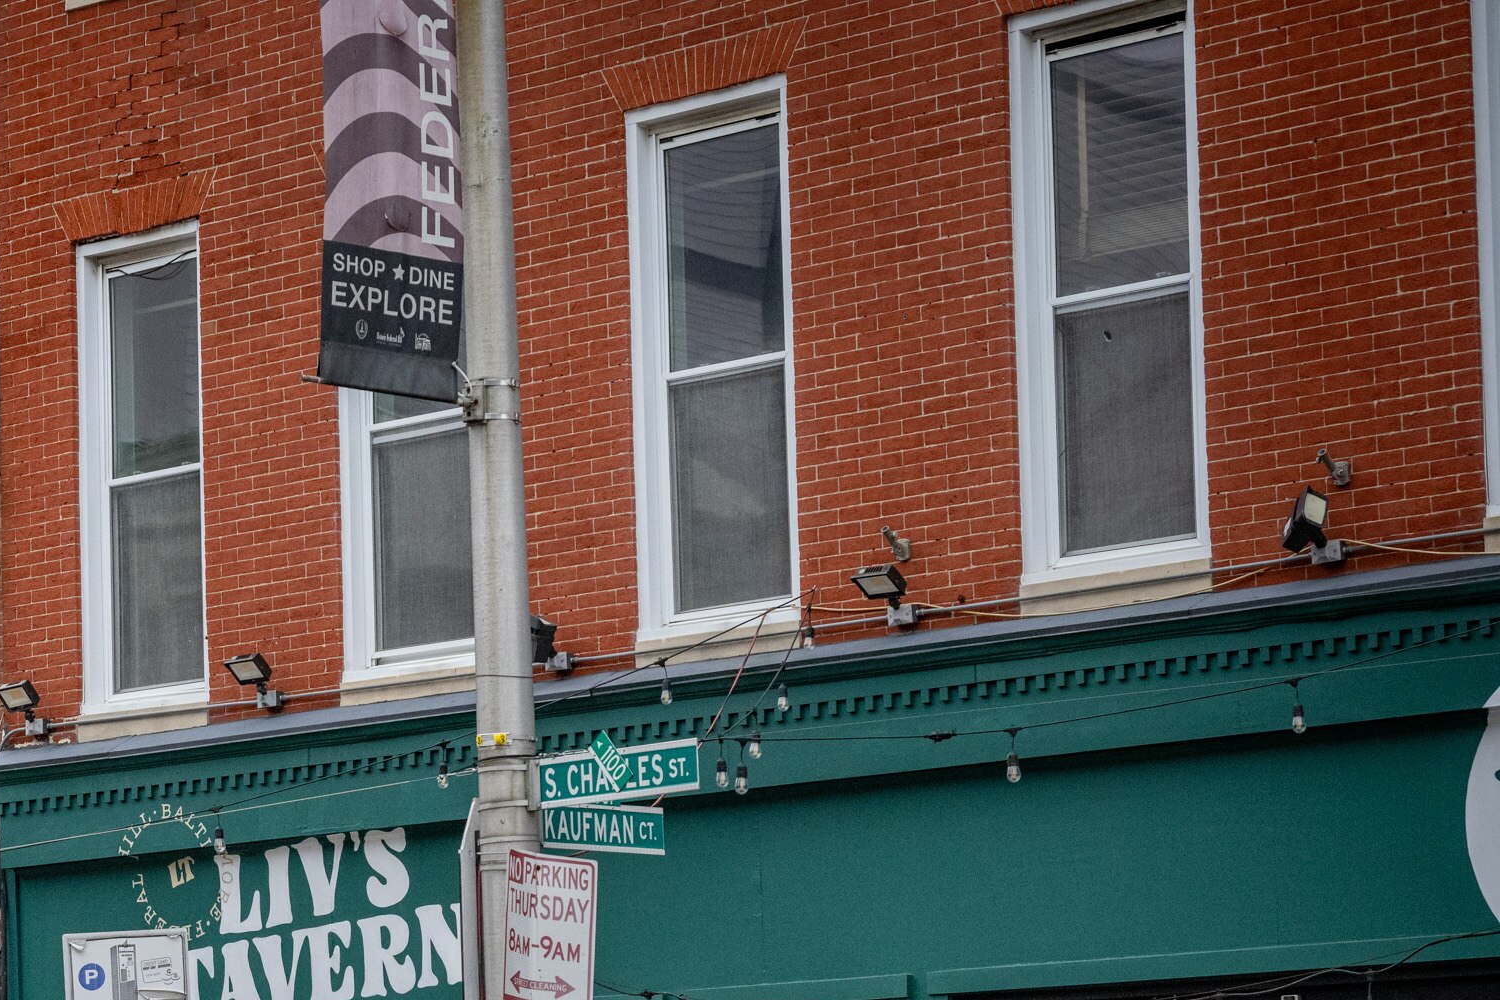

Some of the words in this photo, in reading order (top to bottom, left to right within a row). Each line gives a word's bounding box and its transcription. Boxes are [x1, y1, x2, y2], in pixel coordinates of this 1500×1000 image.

[417, 0, 455, 248] FEDER
[332, 252, 386, 278] SHOP
[409, 266, 455, 291] DINE
[331, 280, 454, 325] EXPLORE
[545, 767, 562, 798] S.
[567, 753, 664, 796] CHALES
[668, 757, 690, 779] ST.
[601, 745, 626, 780] 1100
[544, 809, 635, 844] KAUFMAN
[639, 821, 658, 841] CT.
[167, 855, 195, 889] LT
[214, 827, 410, 935] LIV'S
[509, 855, 523, 883] NO
[525, 861, 589, 891] PARKING
[510, 887, 590, 924] THURSDAY
[85, 969, 99, 985] P
[529, 981, 567, 992] CLEANING
